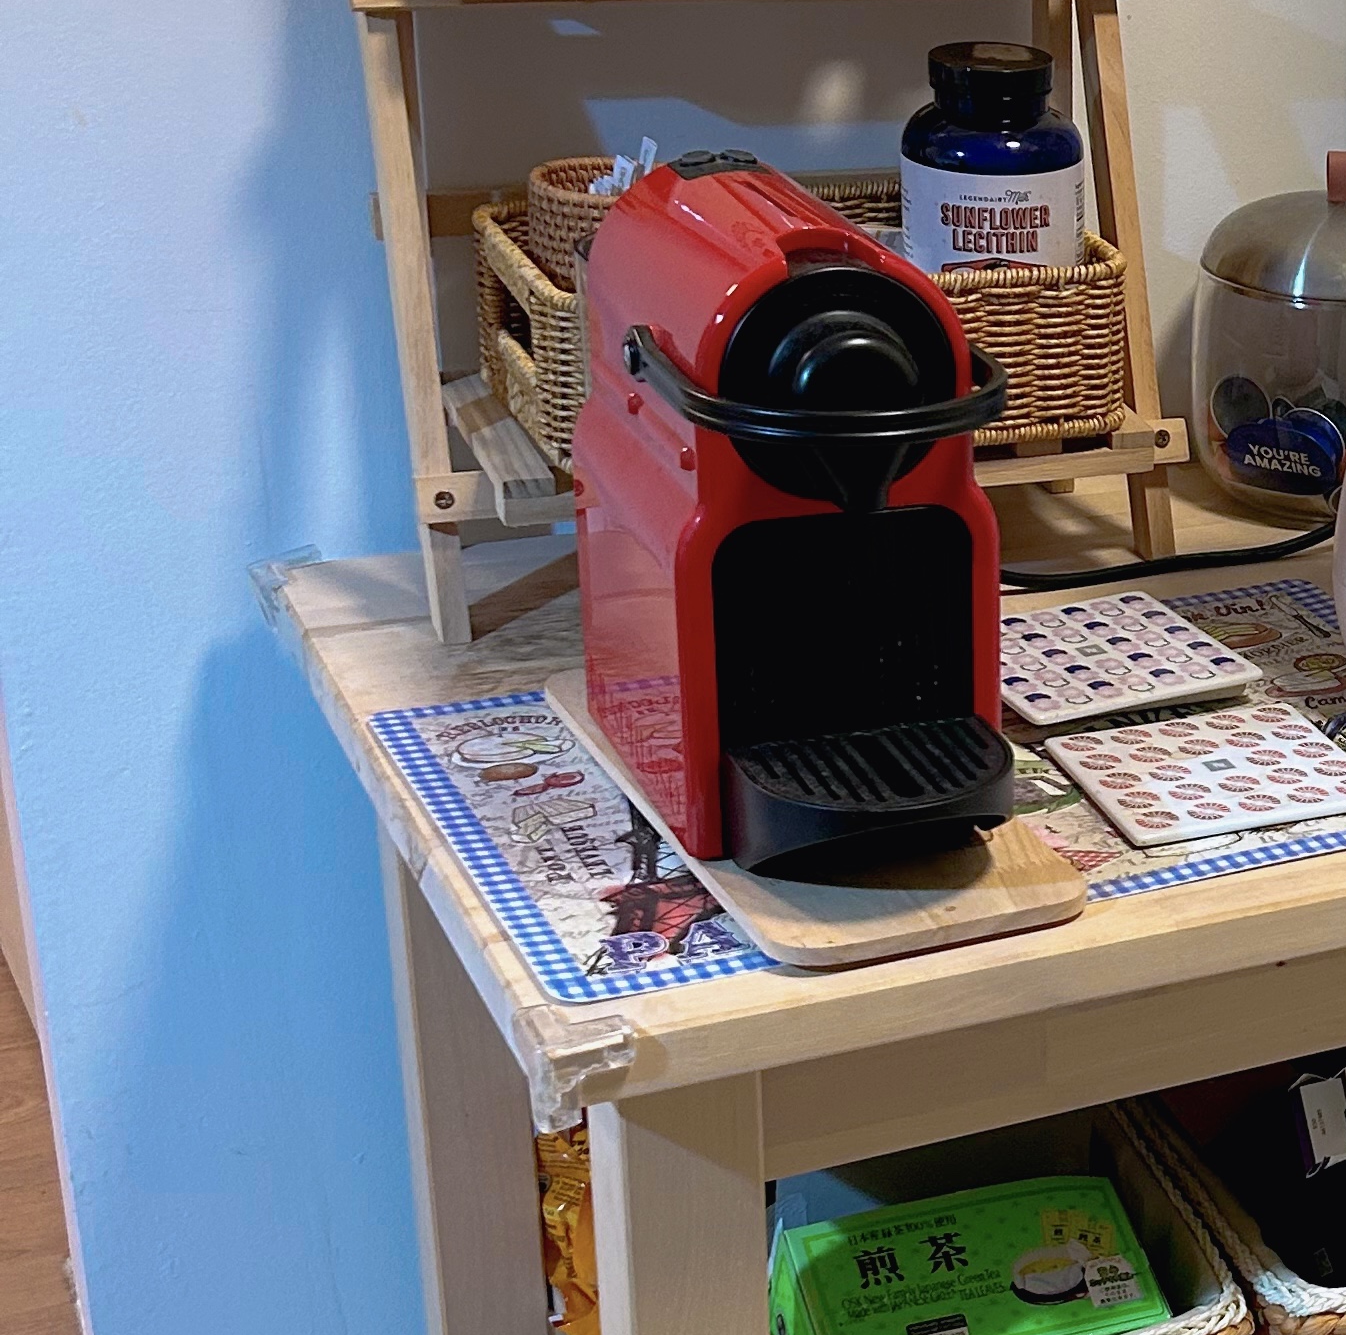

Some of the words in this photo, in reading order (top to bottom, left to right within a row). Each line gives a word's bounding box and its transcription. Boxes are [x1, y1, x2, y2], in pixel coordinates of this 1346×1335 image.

[940, 202, 1050, 231] SUNFLOWER
[952, 228, 1038, 254] LECITHIN
[1243, 453, 1323, 479] AMAZING
[1248, 443, 1310, 465] YOU'RE
[599, 918, 751, 974] PA
